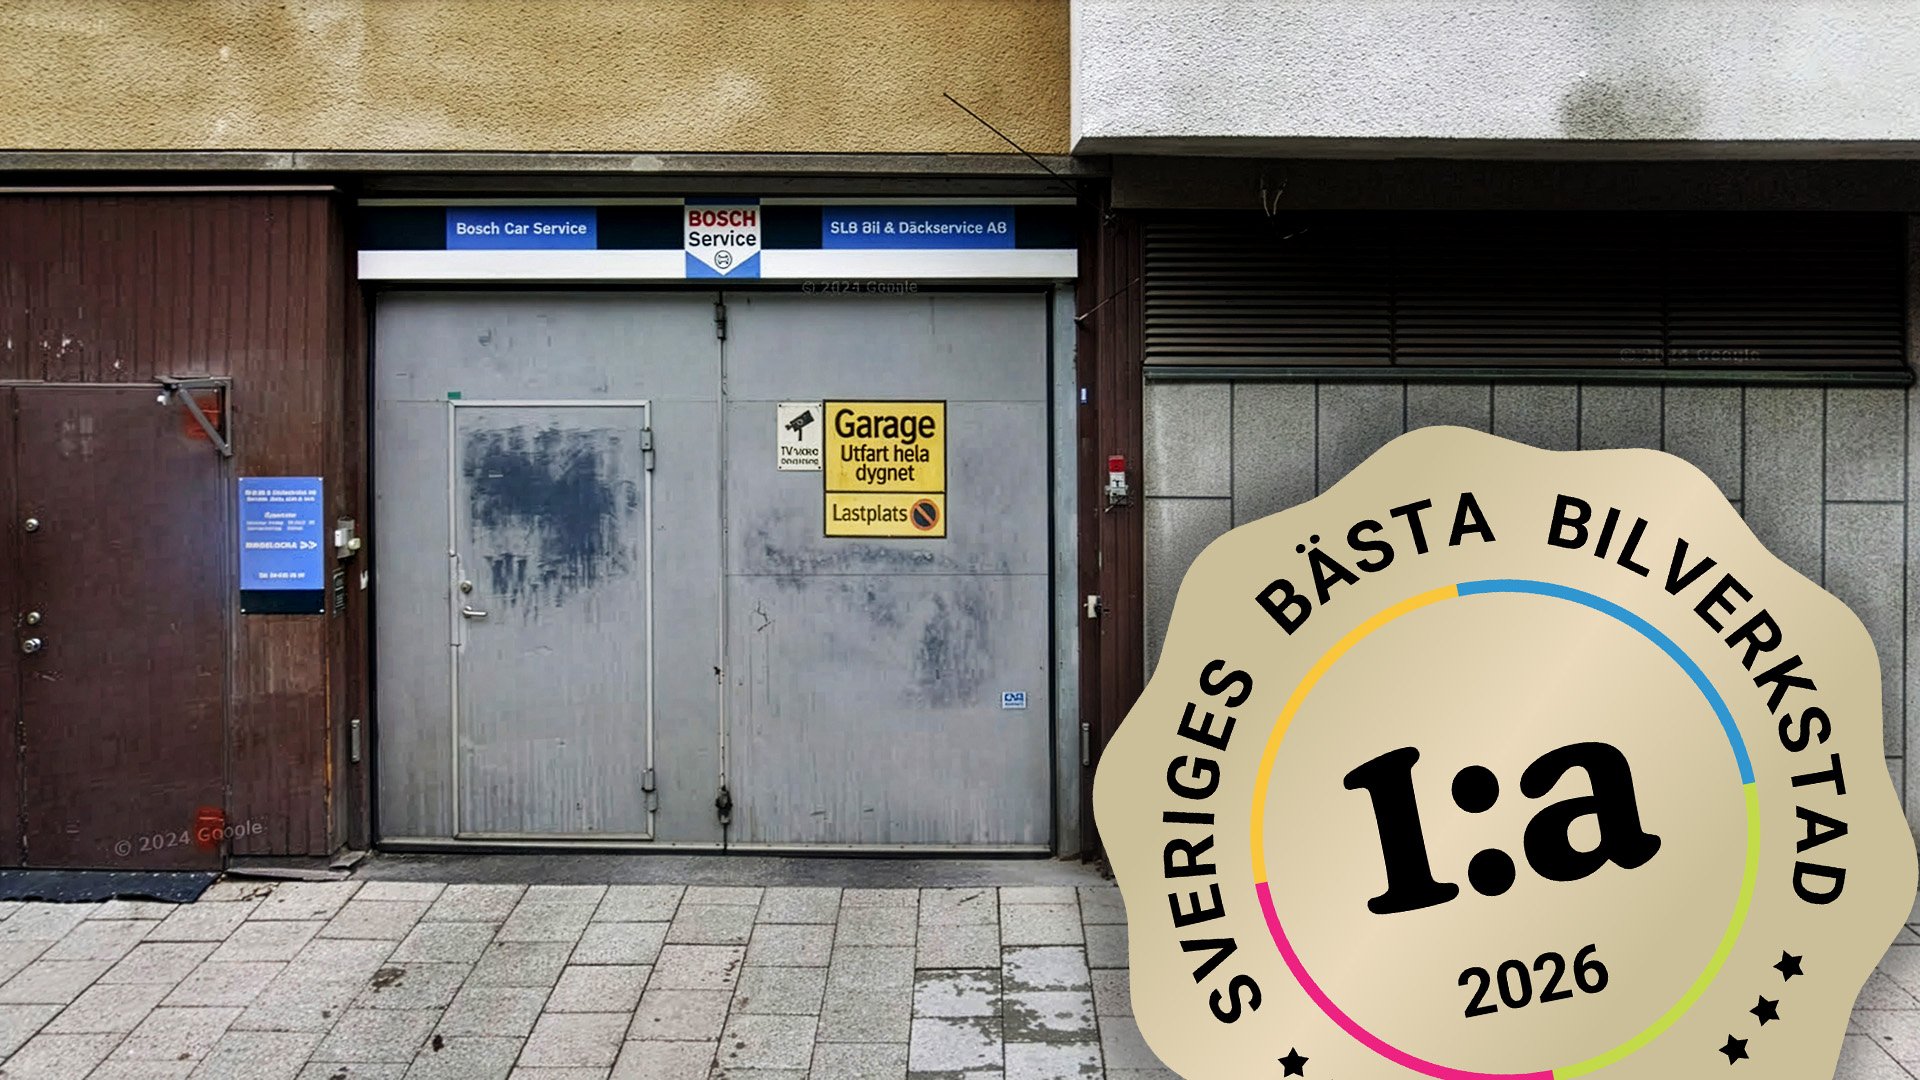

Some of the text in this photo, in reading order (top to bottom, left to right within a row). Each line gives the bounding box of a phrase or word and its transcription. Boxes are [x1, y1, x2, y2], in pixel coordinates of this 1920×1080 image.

[688, 209, 756, 227] BOSCH
[456, 221, 587, 235] Bosch Car Service
[884, 222, 895, 234] &
[899, 221, 983, 234] Däckservice
[688, 230, 757, 247] Service
[835, 408, 936, 445] Garage
[841, 444, 929, 462] Utfart hela
[856, 463, 915, 485] dygnet
[833, 503, 908, 525] Lastplats
